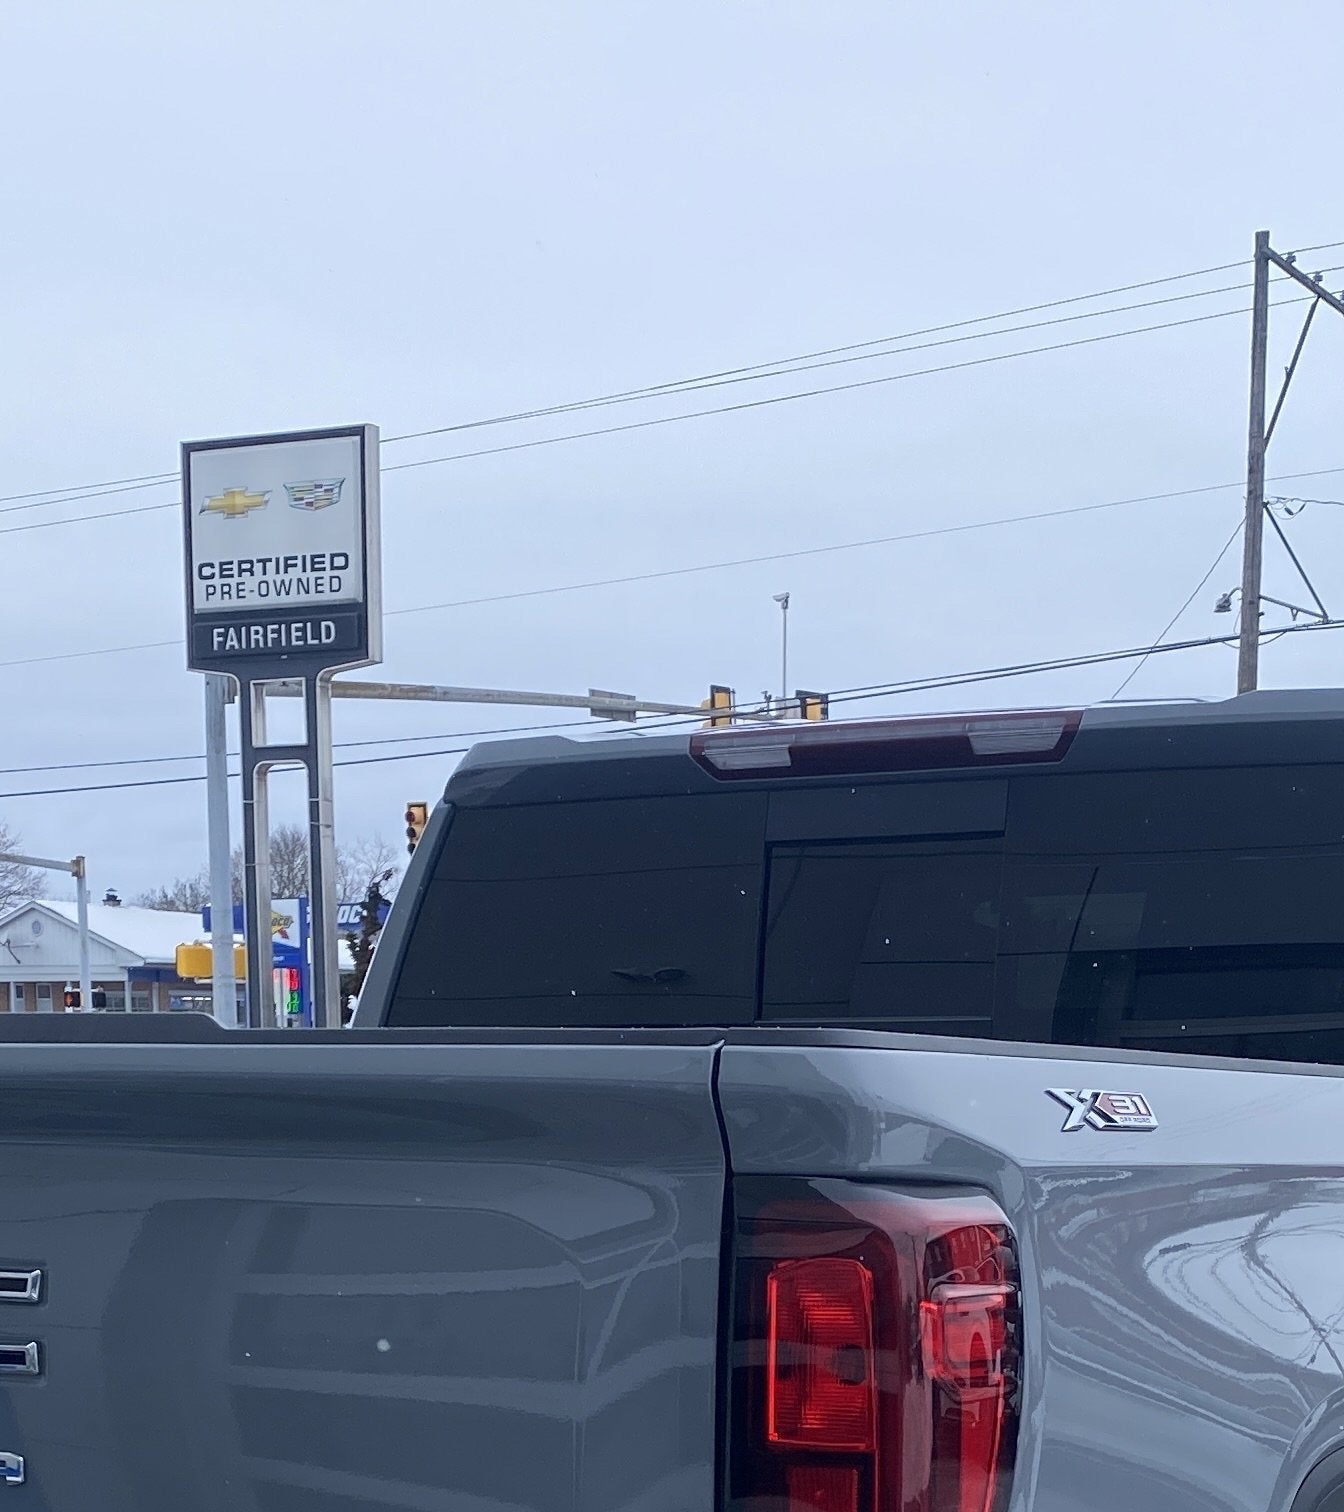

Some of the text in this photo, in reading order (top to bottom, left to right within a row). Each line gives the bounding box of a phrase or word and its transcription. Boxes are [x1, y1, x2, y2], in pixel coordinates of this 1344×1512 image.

[197, 552, 349, 581] CERTIFIED
[205, 576, 342, 602] PRE-OWNED
[212, 620, 336, 651] FAIRFIELD
